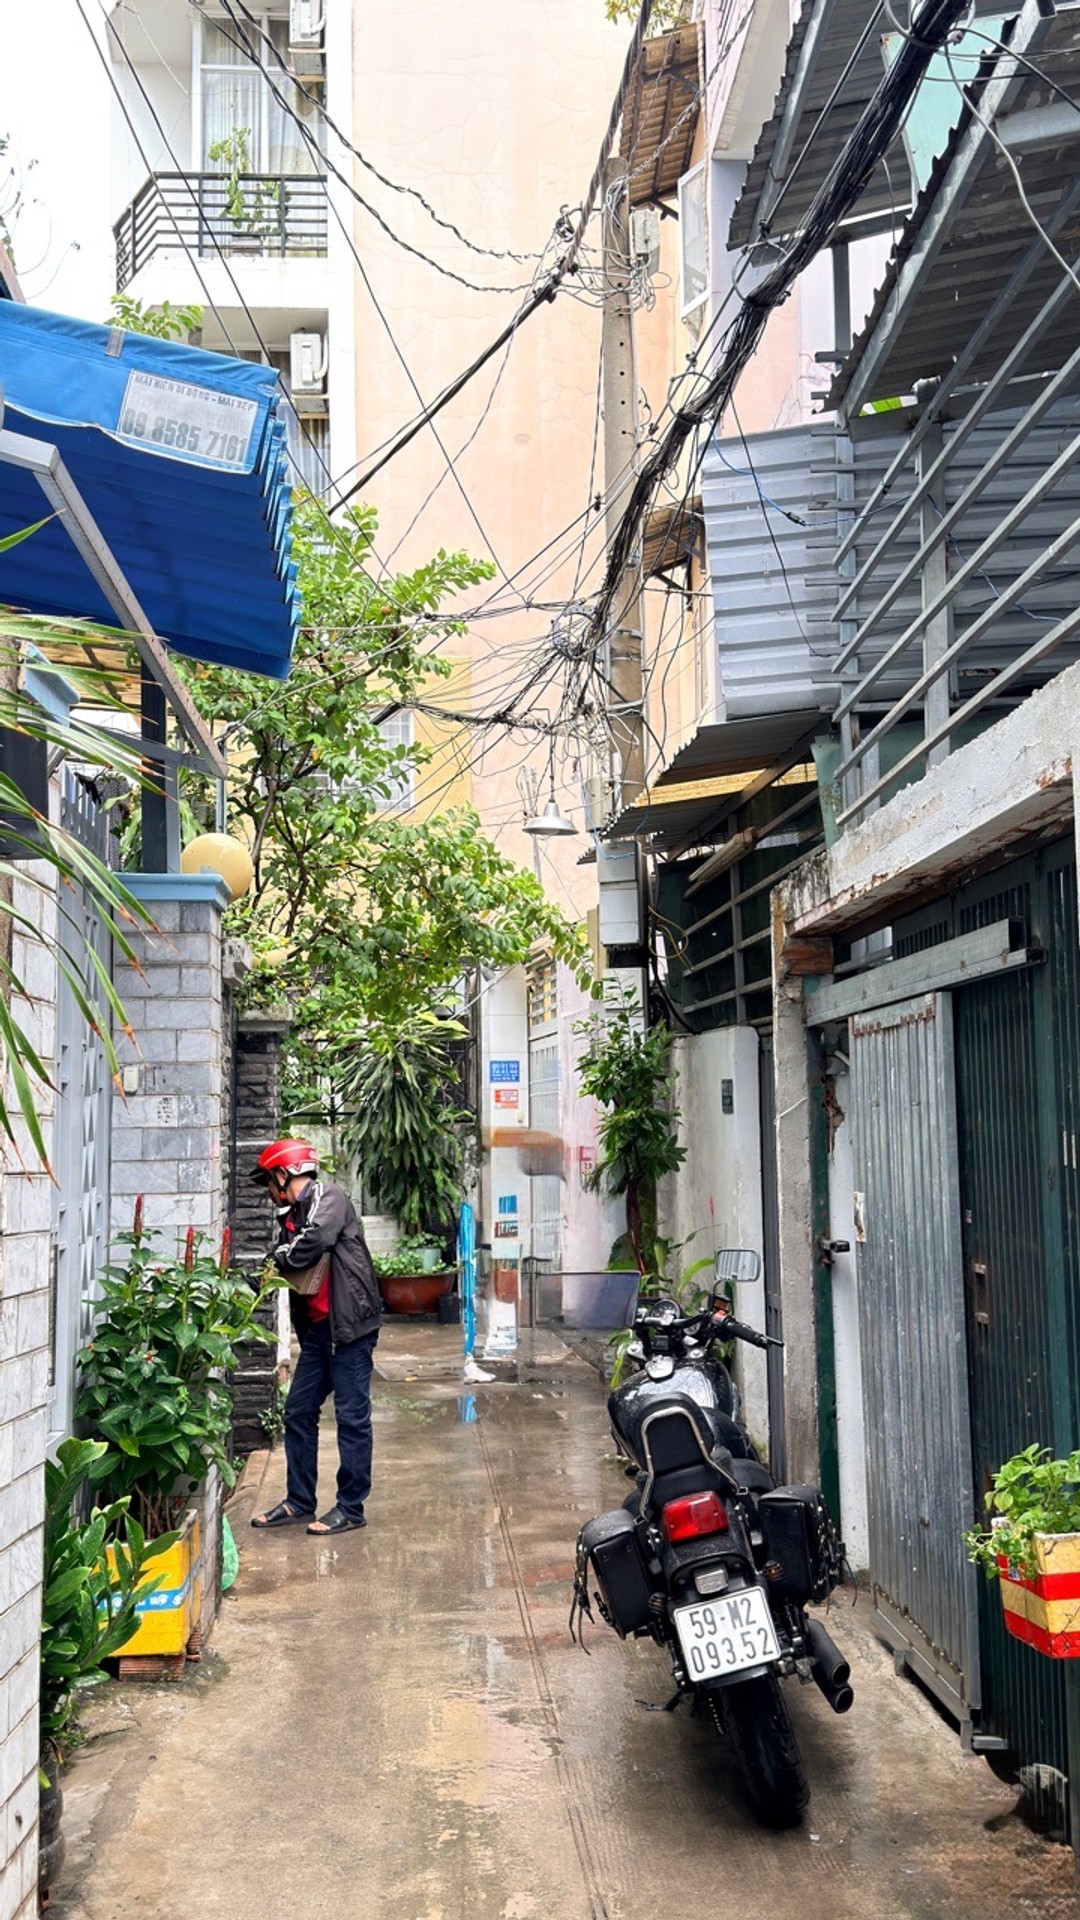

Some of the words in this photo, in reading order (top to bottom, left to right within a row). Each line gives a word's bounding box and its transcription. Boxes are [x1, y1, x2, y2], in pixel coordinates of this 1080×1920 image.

[123, 408, 148, 437] 09
[152, 416, 201, 451] 8585
[206, 430, 247, 460] 7161
[689, 1597, 757, 1639] 59-M2
[690, 1627, 774, 1674] 093.52
